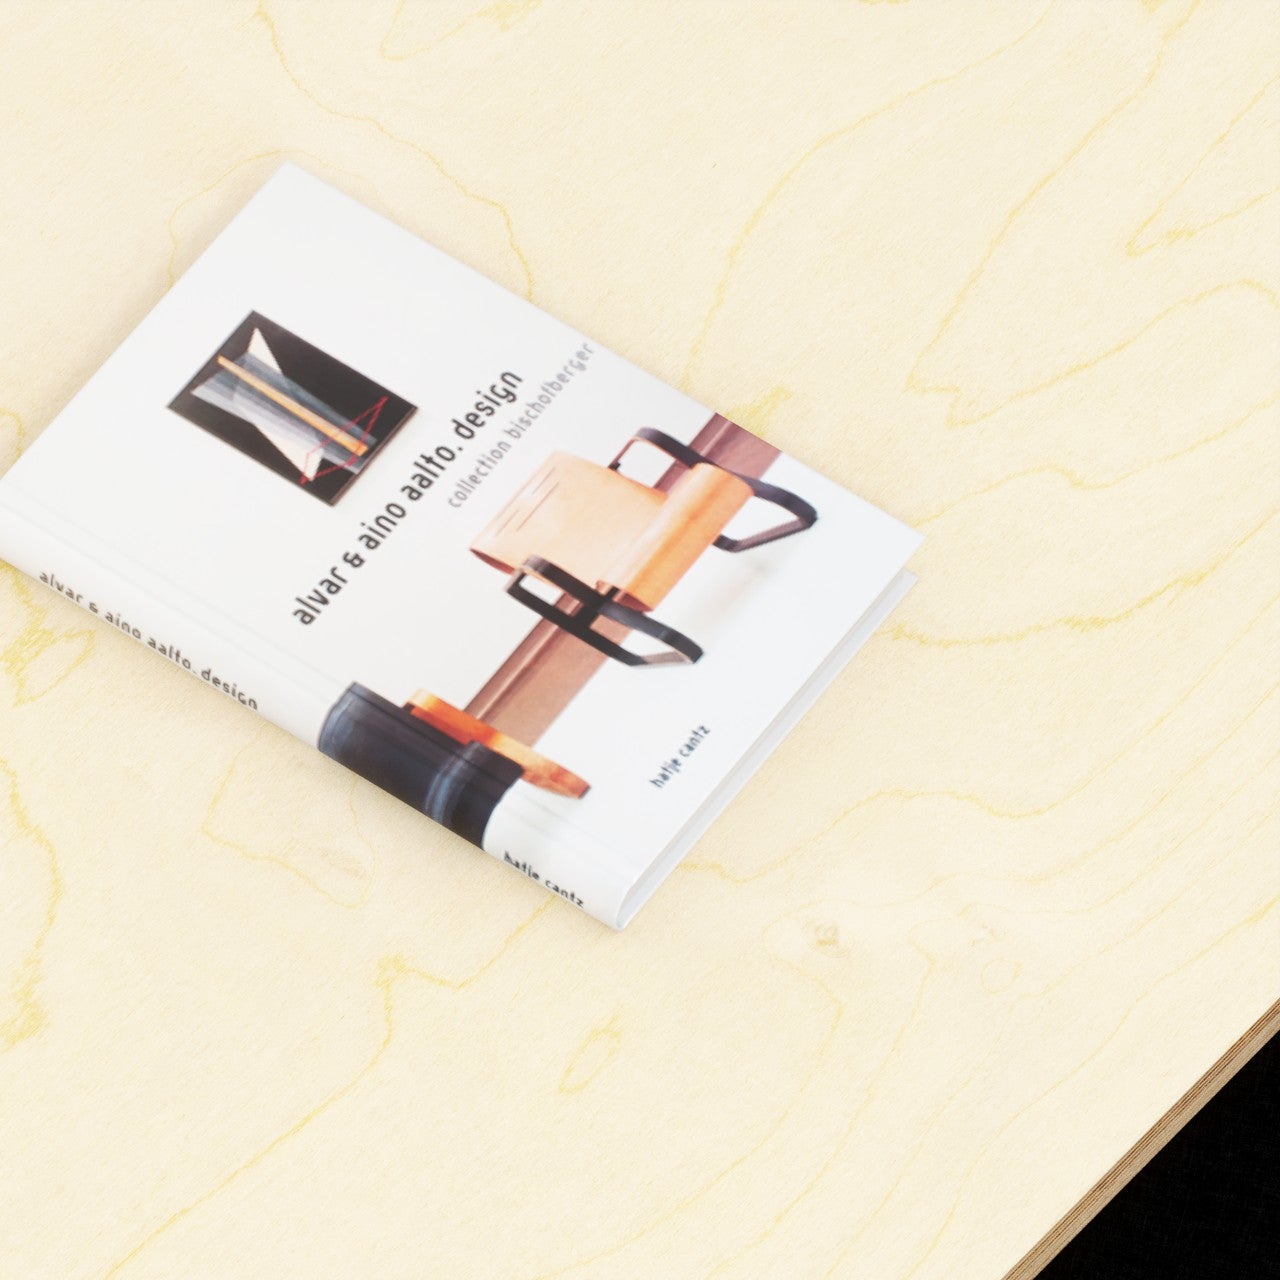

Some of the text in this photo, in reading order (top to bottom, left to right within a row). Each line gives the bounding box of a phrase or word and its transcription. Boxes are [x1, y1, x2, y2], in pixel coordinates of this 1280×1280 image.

[448, 342, 595, 508] collection bischofberger
[293, 567, 348, 625] alvar
[343, 551, 366, 569] &
[358, 501, 407, 551] aino
[451, 370, 523, 441] design
[40, 571, 84, 603] alvar
[105, 613, 141, 639] aino
[650, 724, 711, 788] hatje cantz
[504, 850, 584, 908] hatje cantz
